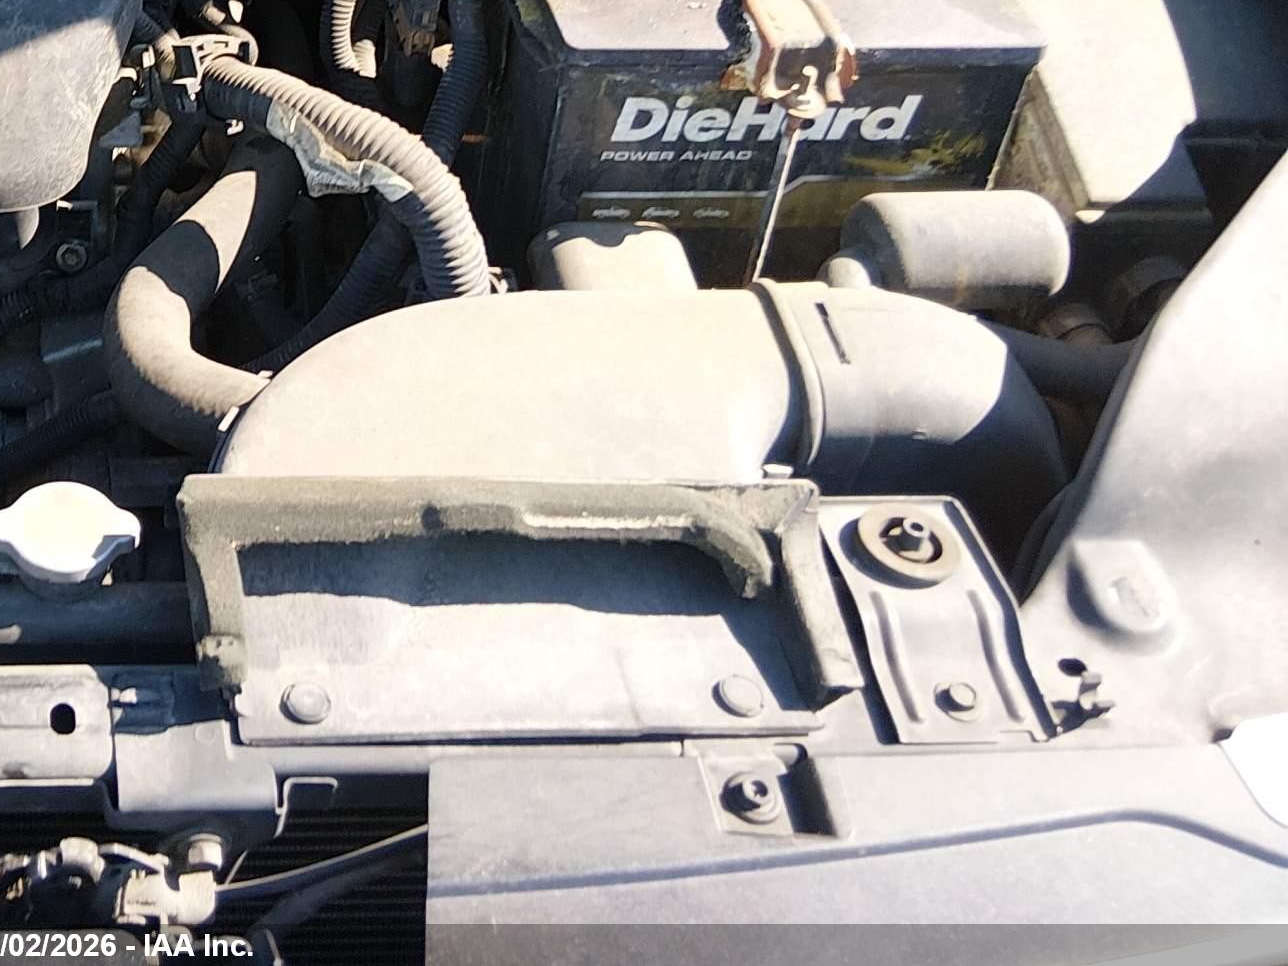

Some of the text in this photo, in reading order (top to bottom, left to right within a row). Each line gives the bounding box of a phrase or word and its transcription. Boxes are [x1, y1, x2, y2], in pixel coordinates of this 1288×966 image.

[610, 94, 923, 142] DieHard
[600, 150, 752, 162] POWER AHEAD
